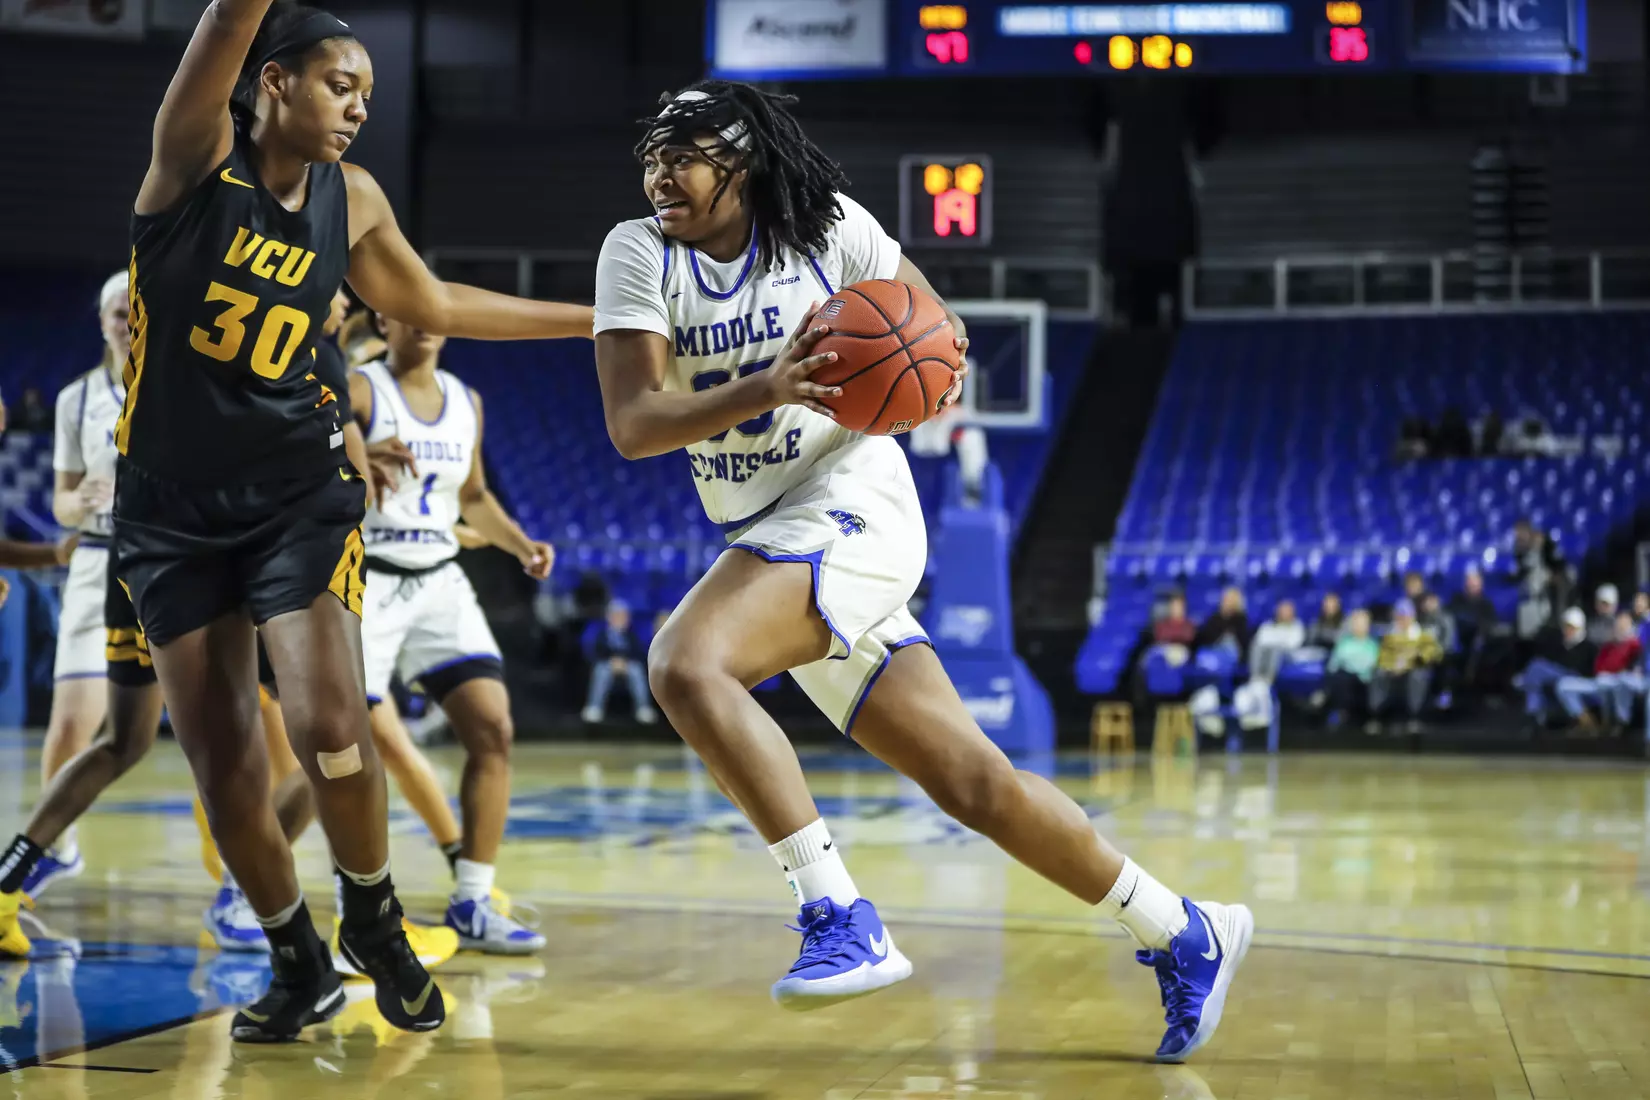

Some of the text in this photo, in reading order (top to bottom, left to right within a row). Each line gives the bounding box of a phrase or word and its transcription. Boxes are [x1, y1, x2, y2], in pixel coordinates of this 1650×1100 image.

[223, 226, 317, 287] VCU
[189, 281, 311, 380] 30
[675, 305, 785, 357] MIDDLE
